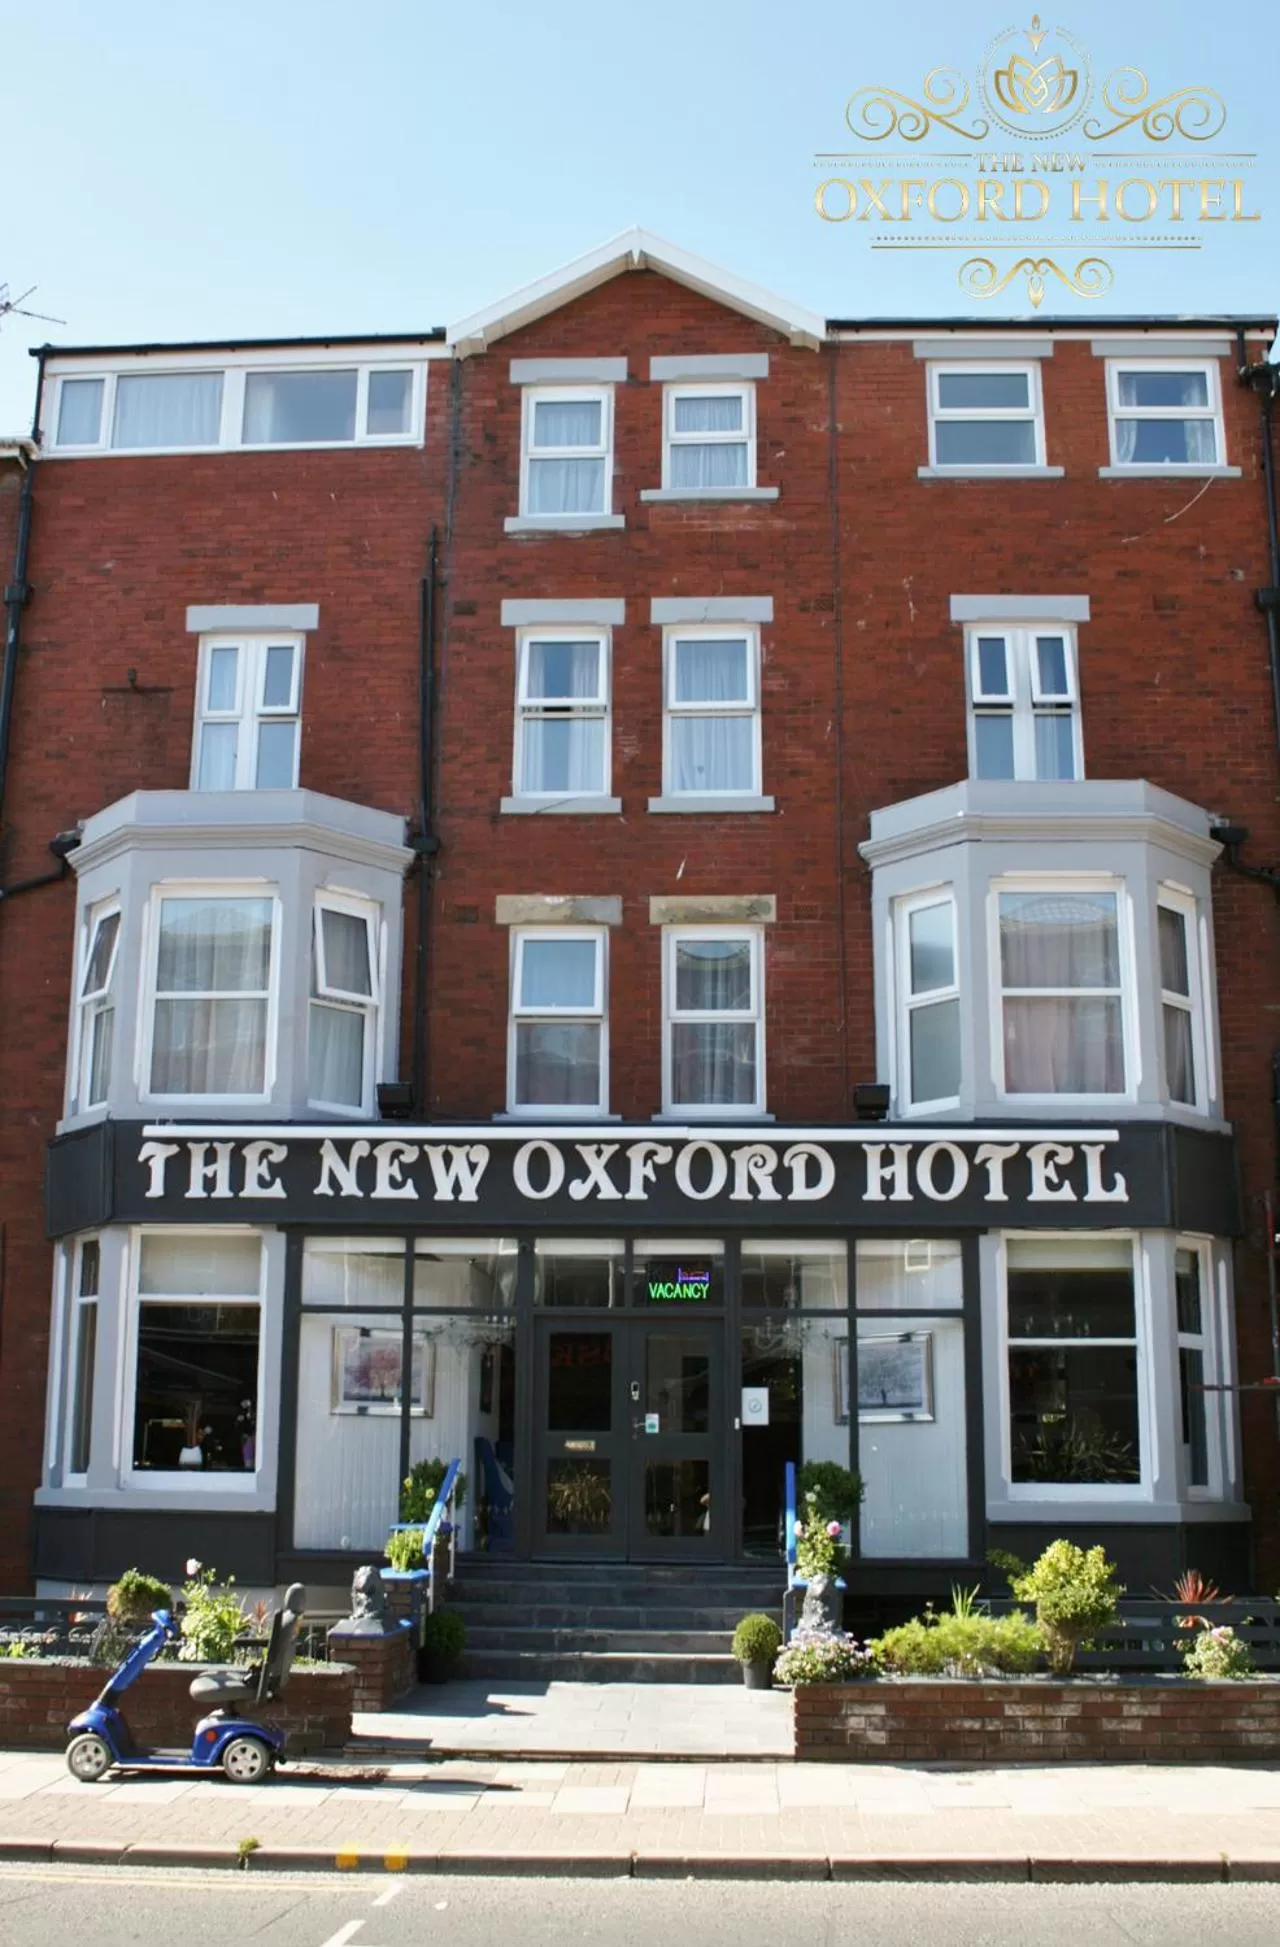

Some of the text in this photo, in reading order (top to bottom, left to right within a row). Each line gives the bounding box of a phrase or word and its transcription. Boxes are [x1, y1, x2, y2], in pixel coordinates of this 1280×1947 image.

[138, 1139, 1129, 1203] THE NEW OXFORD HOTEL
[648, 1282, 710, 1299] VACANCY
